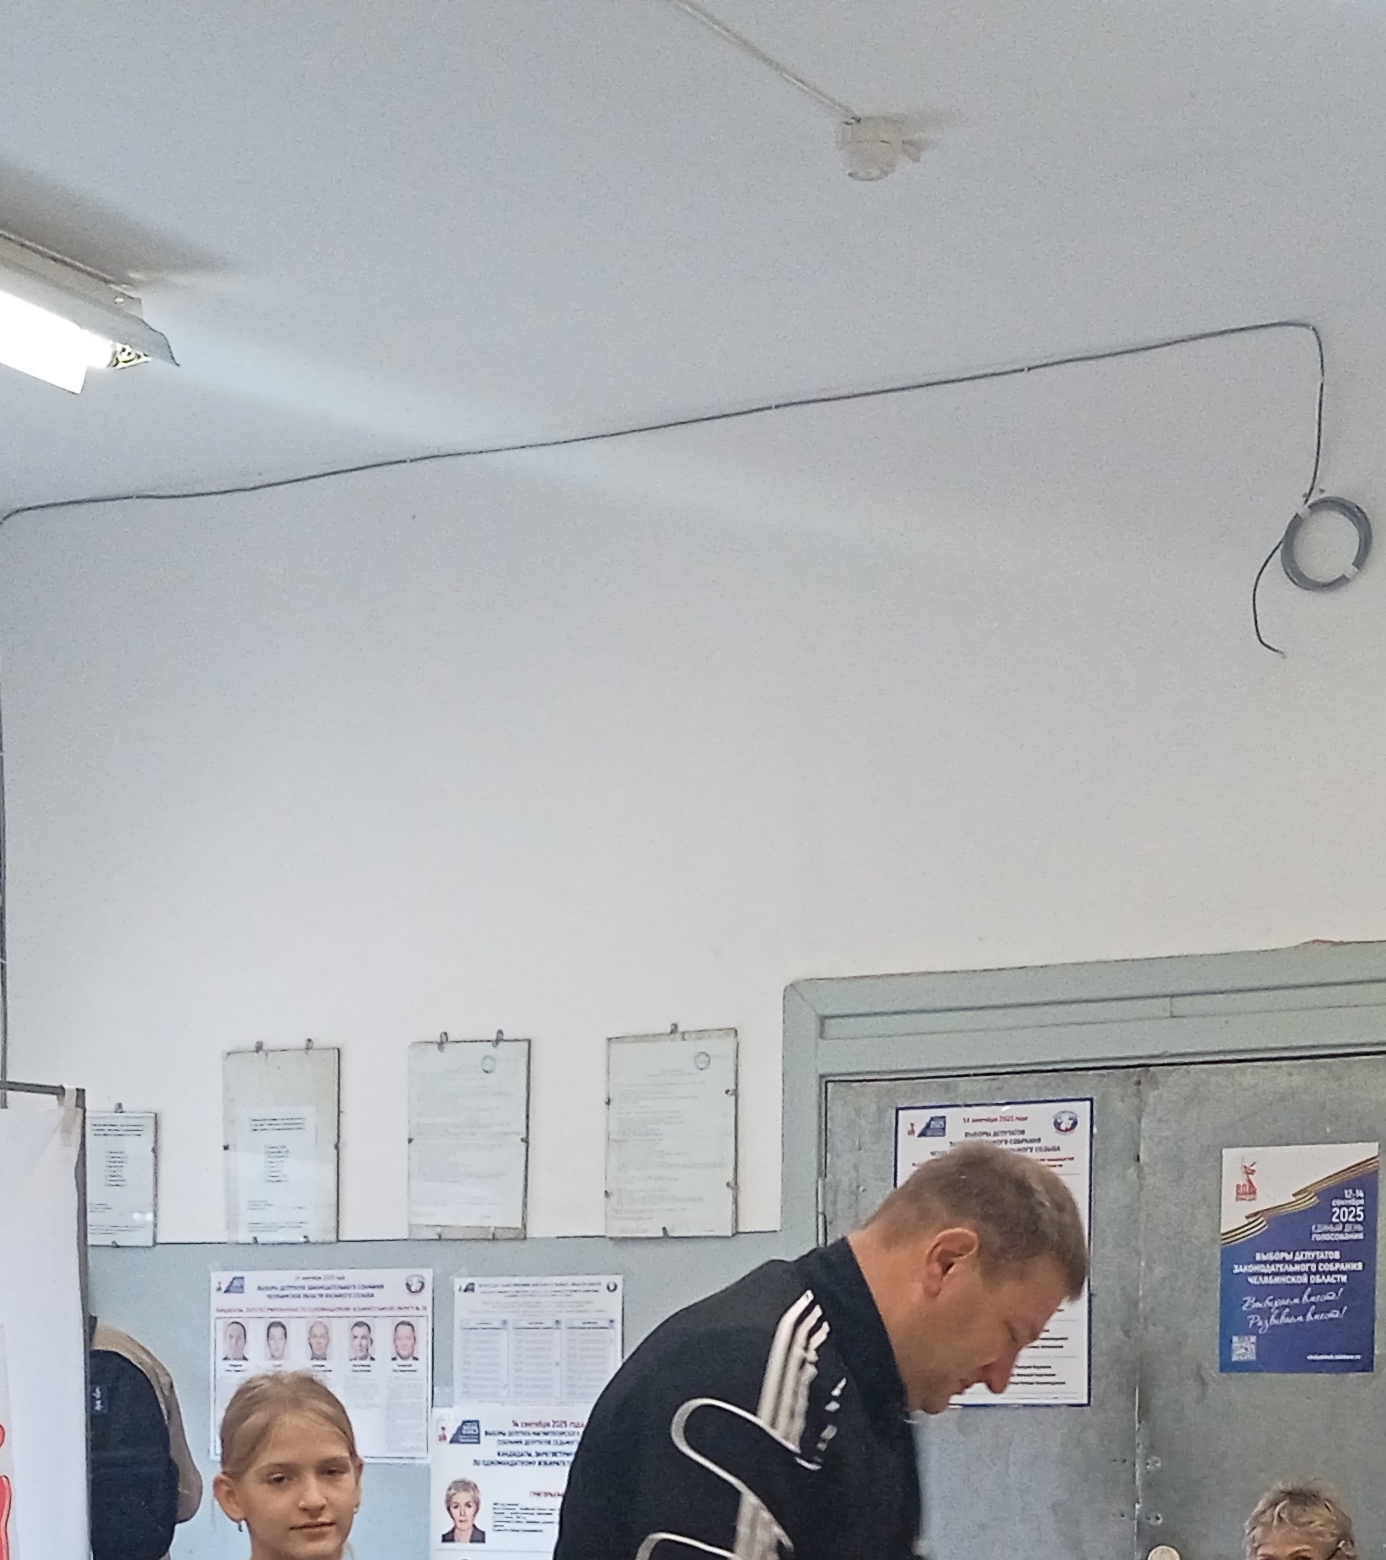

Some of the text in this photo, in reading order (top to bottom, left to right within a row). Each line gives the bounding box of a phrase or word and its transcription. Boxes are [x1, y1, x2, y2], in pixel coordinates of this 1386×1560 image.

[1331, 1206, 1365, 1222] 2025
[1256, 1250, 1341, 1261] ВЫБОРЫ ДЕПУТАТОВ
[1233, 1262, 1363, 1274] ЗАКОНОДАТЕЛЬНОГО СОБРАНИЯ
[1310, 1274, 1348, 1283] ОБЛАСТИ
